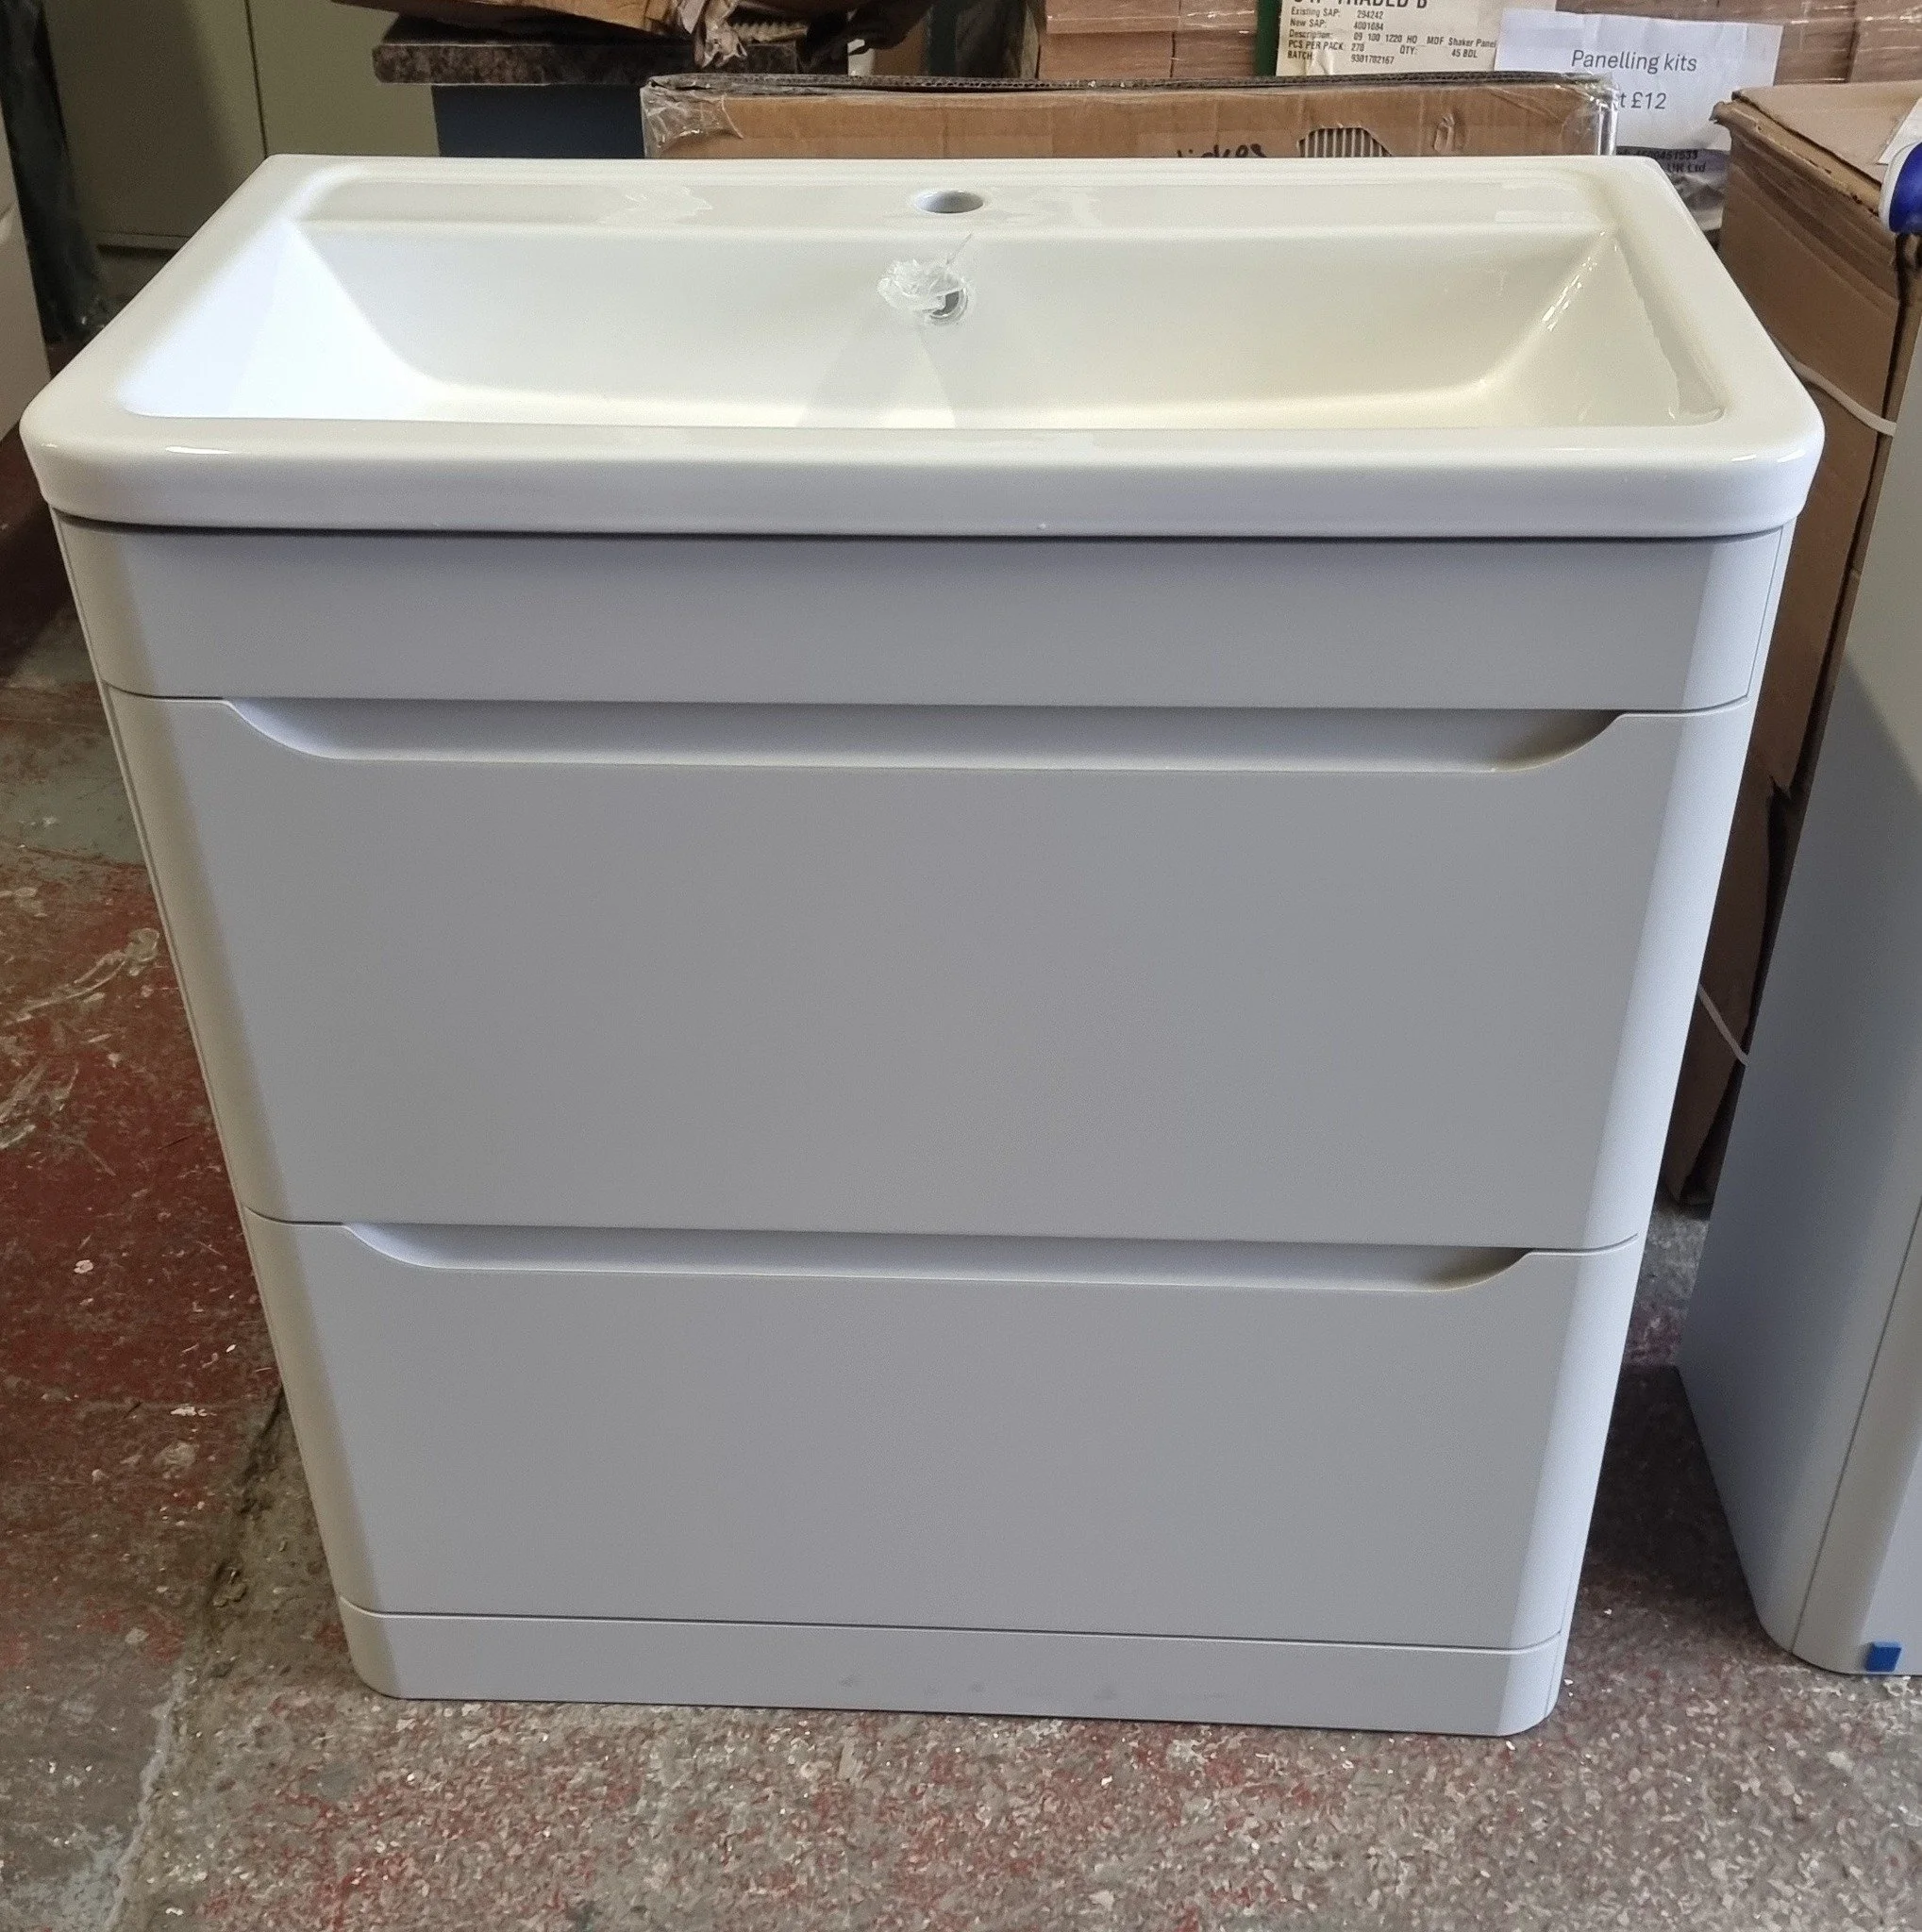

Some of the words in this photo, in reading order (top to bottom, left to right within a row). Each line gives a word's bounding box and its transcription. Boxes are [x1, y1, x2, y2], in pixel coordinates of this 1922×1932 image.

[1291, 7, 1321, 17] Existing
[1290, 18, 1306, 26] New
[1288, 39, 1303, 49] PCS
[1305, 41, 1321, 50] PER
[1427, 36, 1445, 45] MDF
[1448, 37, 1474, 46] Shaker
[1571, 49, 1660, 75] Panelling
[1663, 53, 1697, 72] kits
[1631, 92, 1666, 109] £12
